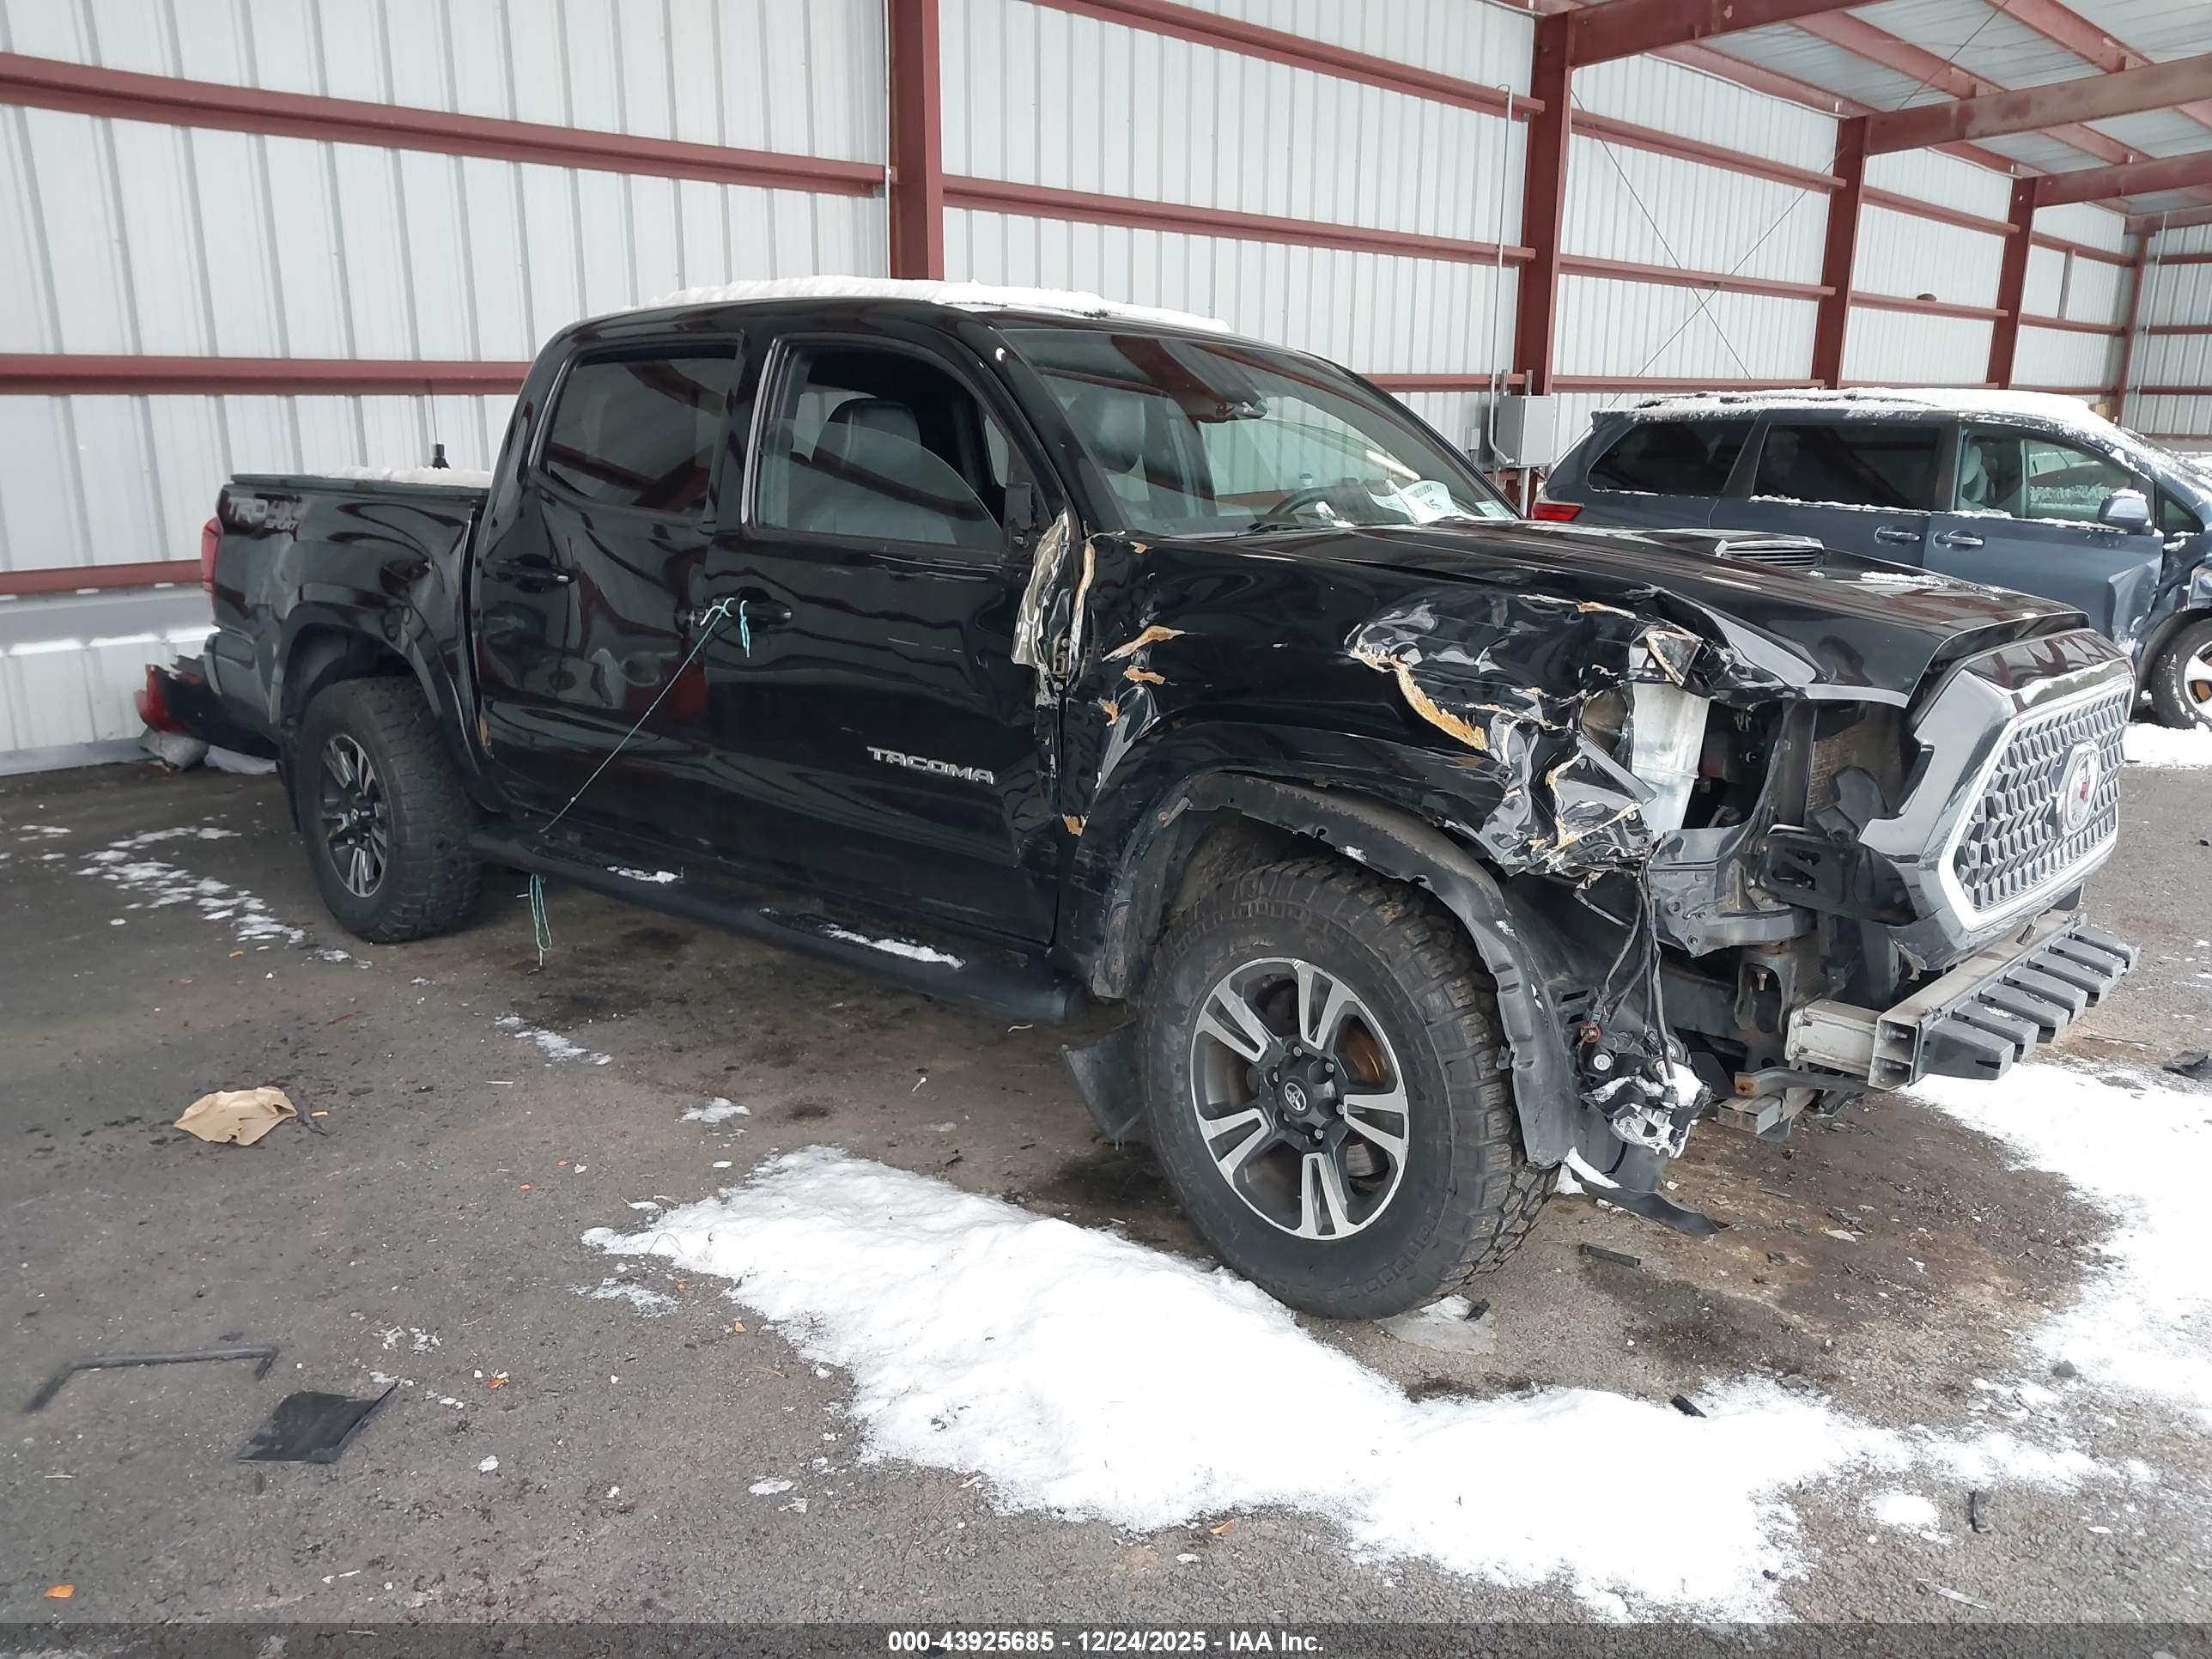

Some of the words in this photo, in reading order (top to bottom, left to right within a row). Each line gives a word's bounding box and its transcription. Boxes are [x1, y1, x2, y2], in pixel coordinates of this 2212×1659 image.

[228, 496, 268, 522] TRD
[264, 518, 299, 530] SPORT
[866, 745, 995, 785] TACOMA
